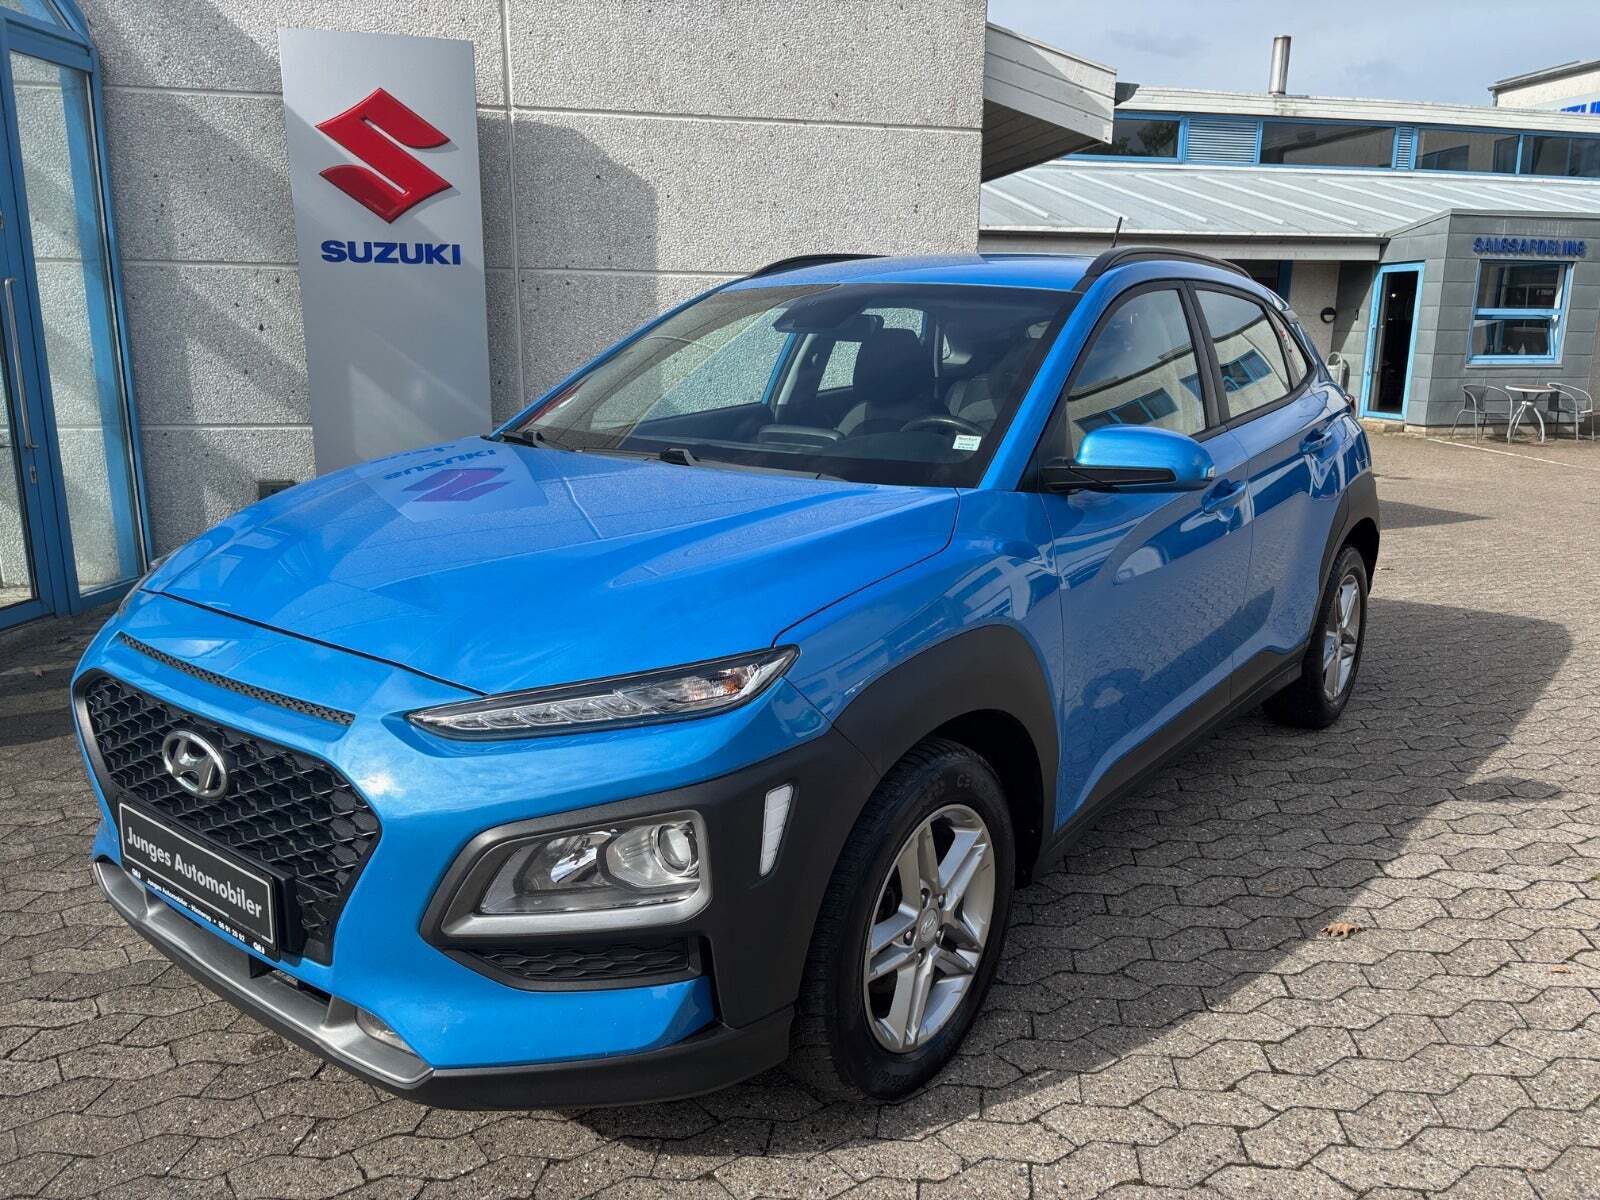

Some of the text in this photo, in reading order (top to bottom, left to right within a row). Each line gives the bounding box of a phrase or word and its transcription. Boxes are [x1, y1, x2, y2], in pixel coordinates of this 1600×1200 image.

[320, 239, 462, 265] SUZUKI
[127, 826, 263, 919] Junges Automobiler
